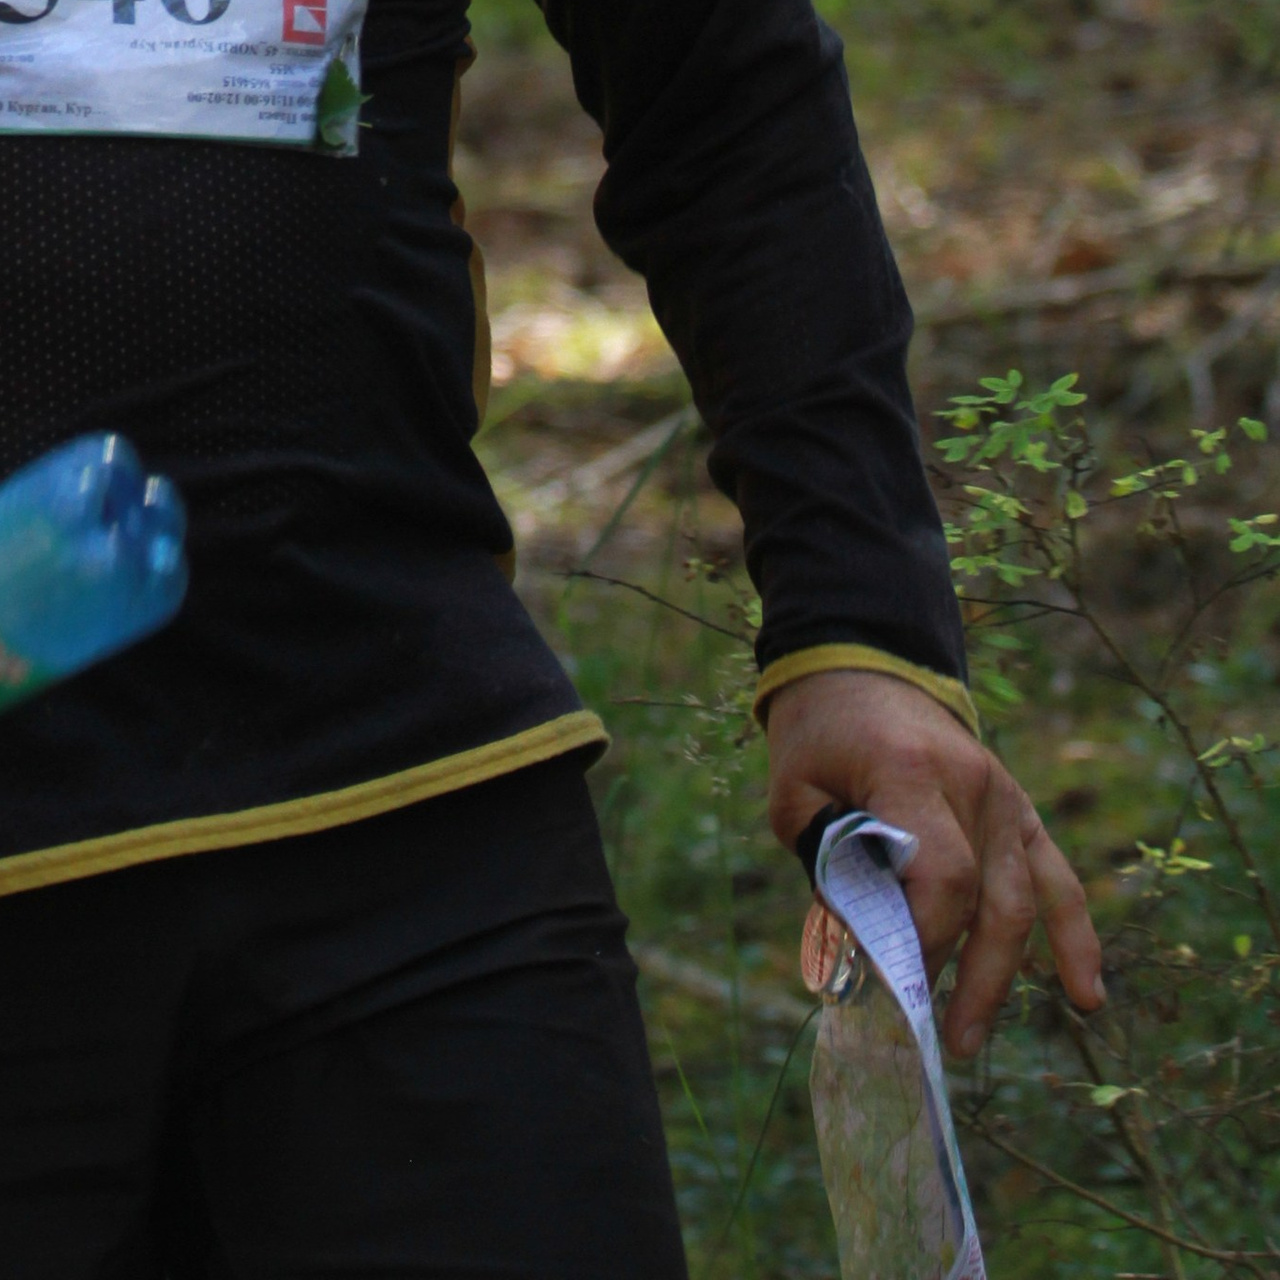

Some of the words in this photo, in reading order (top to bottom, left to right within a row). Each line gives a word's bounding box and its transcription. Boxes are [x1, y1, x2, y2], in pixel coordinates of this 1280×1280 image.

[187, 93, 241, 106] 12:02:00
[244, 94, 294, 108] 11:16:00
[7, 101, 62, 117] Курган,
